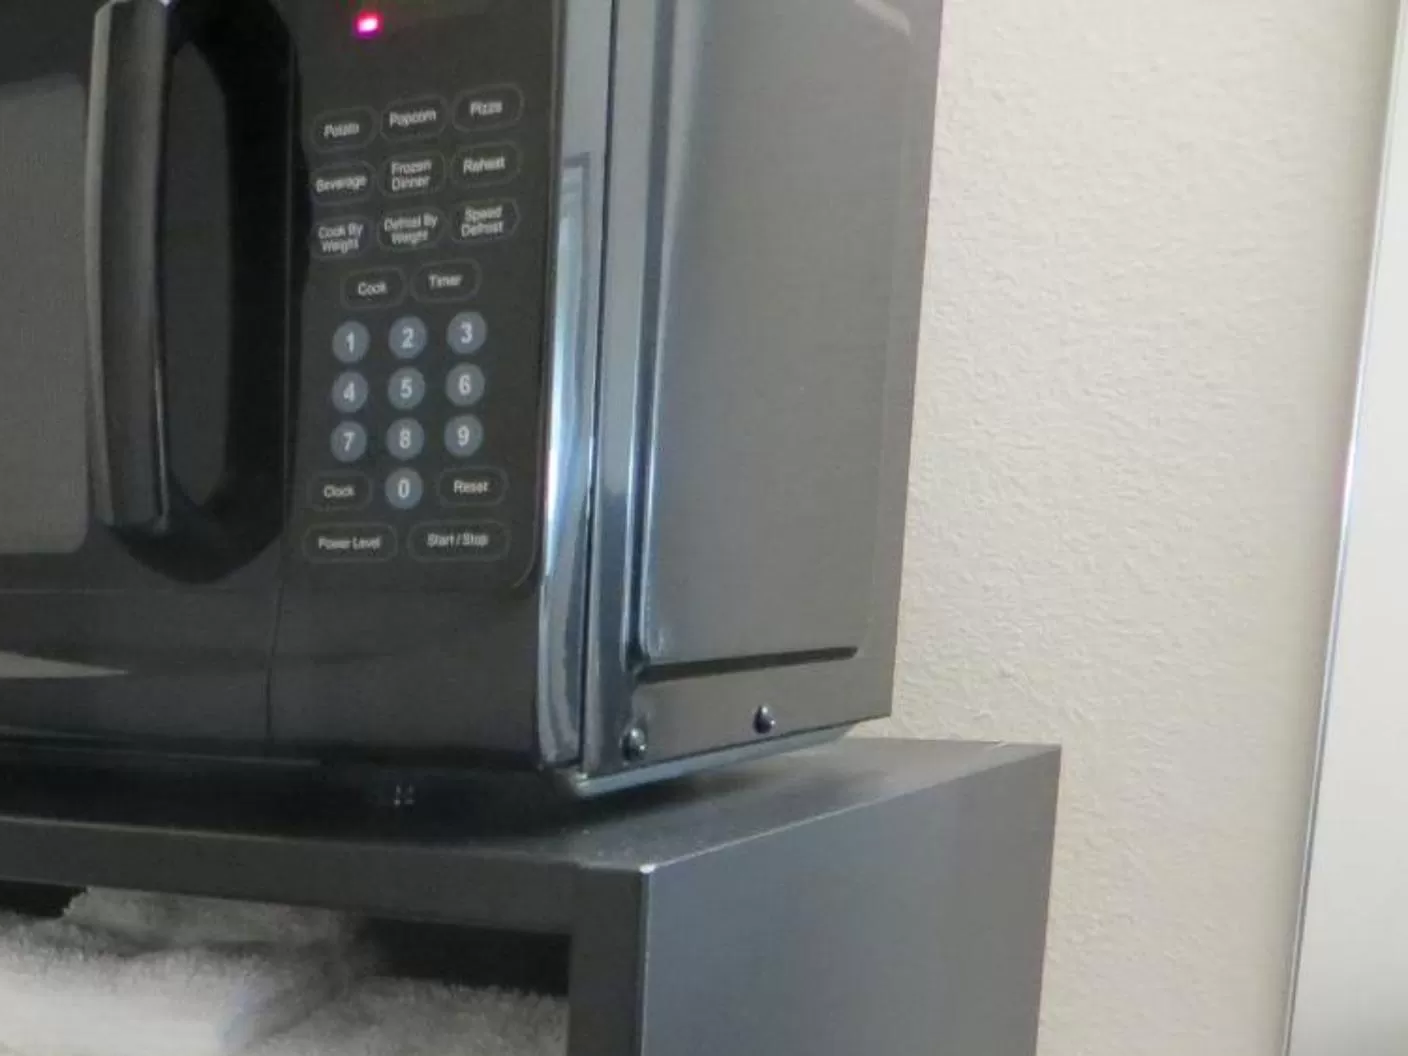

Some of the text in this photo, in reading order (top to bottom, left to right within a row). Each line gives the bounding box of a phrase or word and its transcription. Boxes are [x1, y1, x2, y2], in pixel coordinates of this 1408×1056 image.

[469, 101, 503, 117] Pizza
[389, 109, 438, 128] Popcorn
[323, 122, 361, 139] Potato
[391, 160, 433, 176] Frozen
[463, 156, 507, 175] Reheat
[315, 175, 367, 192] Beverage
[391, 175, 431, 191] Dinner
[423, 212, 439, 228] By
[464, 205, 504, 222] Speed
[317, 222, 365, 240] Cook By
[461, 221, 504, 239] Defrost
[321, 237, 360, 255] Weight
[357, 281, 389, 297] Cook
[428, 274, 463, 289] Timer
[401, 326, 414, 350] 2
[459, 321, 473, 345] 3
[346, 331, 356, 354] 1
[343, 381, 356, 403] 4
[400, 377, 413, 400] 5
[458, 374, 472, 396] 6
[343, 431, 356, 452] 7
[399, 428, 412, 450] 8
[457, 424, 471, 447] 9
[323, 484, 355, 498] Clock
[397, 476, 411, 500] 0
[453, 479, 489, 494] Reset
[318, 535, 382, 550] Power Level
[426, 532, 456, 547] Start
[463, 531, 490, 547] Stop
